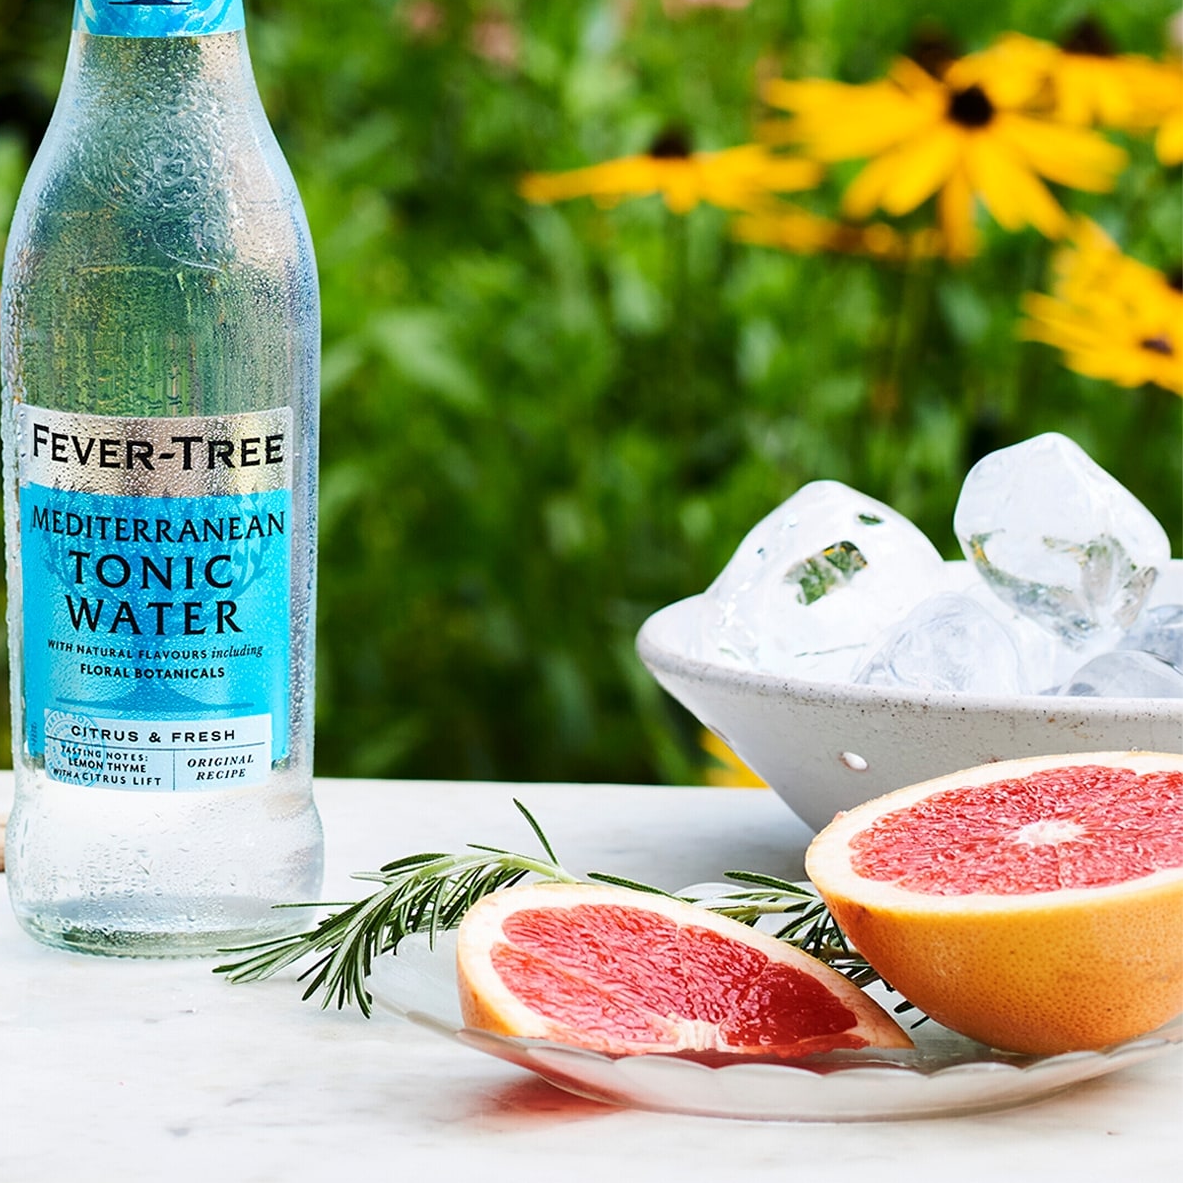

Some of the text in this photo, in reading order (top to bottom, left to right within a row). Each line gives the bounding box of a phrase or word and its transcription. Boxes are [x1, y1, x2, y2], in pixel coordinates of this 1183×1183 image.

[33, 423, 284, 470] FEVER-TREE
[31, 505, 285, 544] MEDITERRANEAN
[68, 550, 233, 591] TONIC
[65, 594, 243, 635] WATER
[47, 639, 263, 660] WITH NATURAL FLAVOURS including
[80, 663, 225, 679] FLORAL BOTANICALS
[70, 725, 235, 743] CITRUS & FRESH
[61, 745, 102, 758] TASTING
[106, 752, 148, 762] NOTES:
[187, 754, 254, 768] ORIGINAL
[68, 757, 146, 773] LEMON THYME
[82, 772, 126, 784] CITRUS
[133, 776, 161, 786] LIFT
[196, 768, 246, 780] RECIPE
